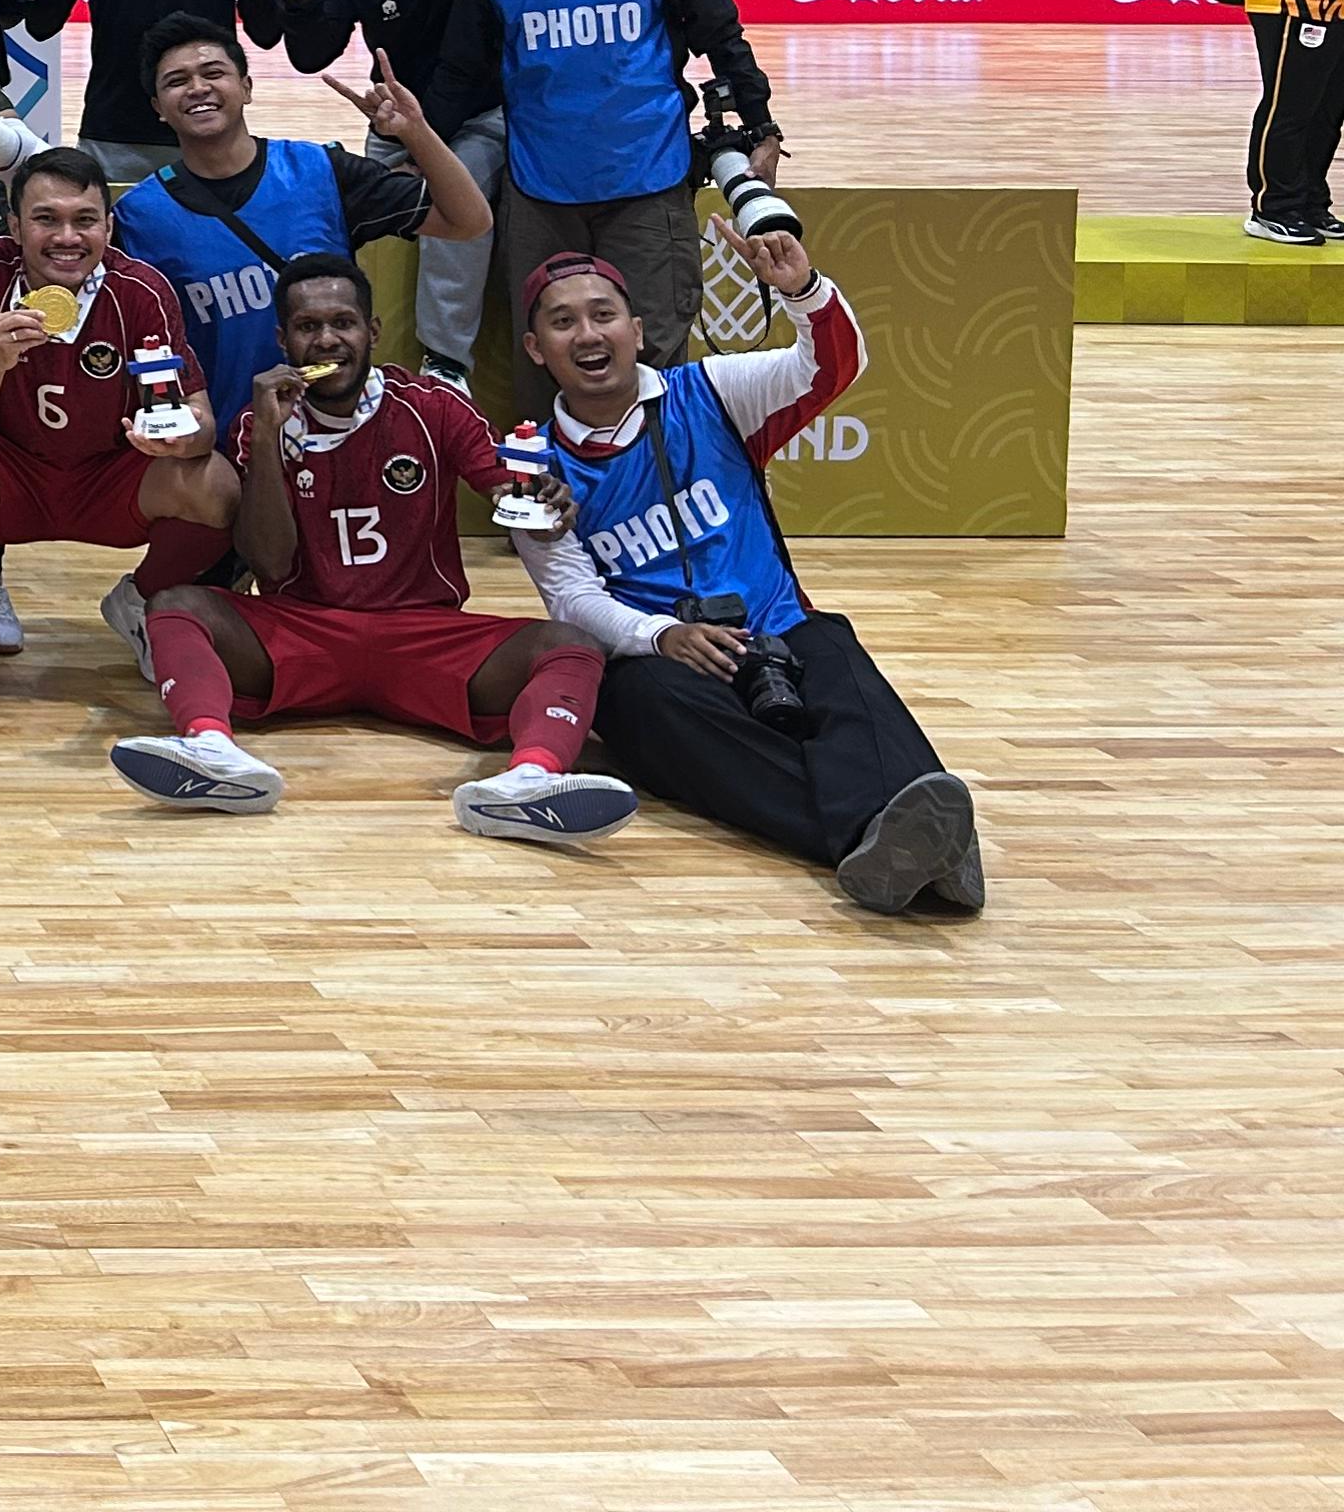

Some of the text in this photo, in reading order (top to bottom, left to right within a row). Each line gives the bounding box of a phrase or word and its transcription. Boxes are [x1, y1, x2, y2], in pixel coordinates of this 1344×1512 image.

[522, 1, 642, 51] PHOTO
[184, 258, 281, 324] PHO
[37, 384, 68, 429] 6
[330, 506, 388, 566] 13
[588, 478, 730, 576] PHOTO
